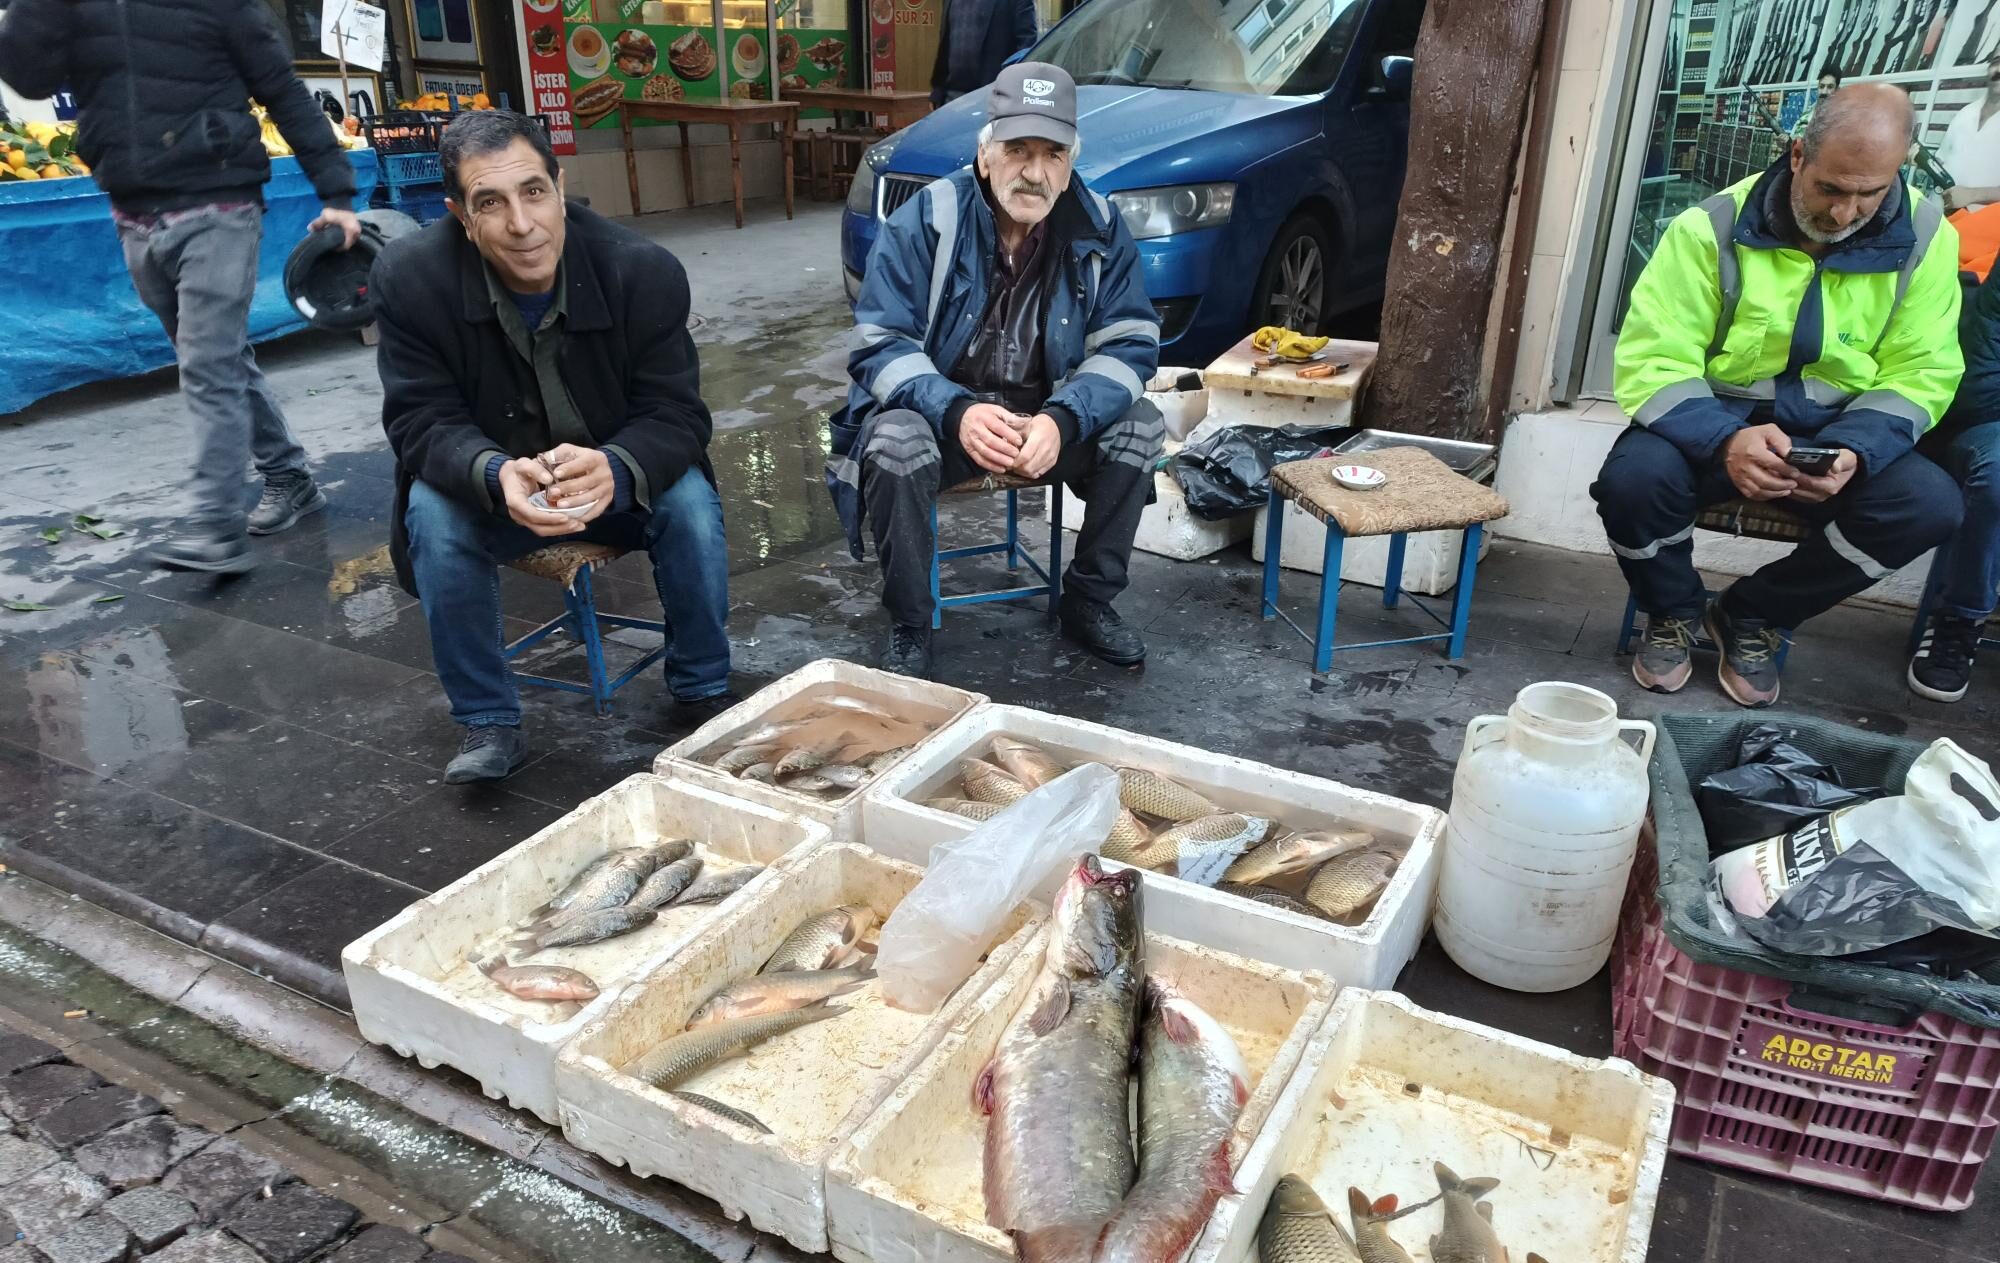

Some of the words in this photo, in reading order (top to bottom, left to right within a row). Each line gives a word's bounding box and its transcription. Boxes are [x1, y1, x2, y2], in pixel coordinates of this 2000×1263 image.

[895, 10, 917, 24] SUR
[921, 11, 933, 24] 21
[534, 70, 567, 89] İSTER
[539, 89, 566, 108] KİLO
[538, 108, 572, 126] İTER
[1762, 1049, 1783, 1063] K1
[1787, 1056, 1825, 1072] NO:1
[1766, 1035, 1896, 1072] ADGTAR
